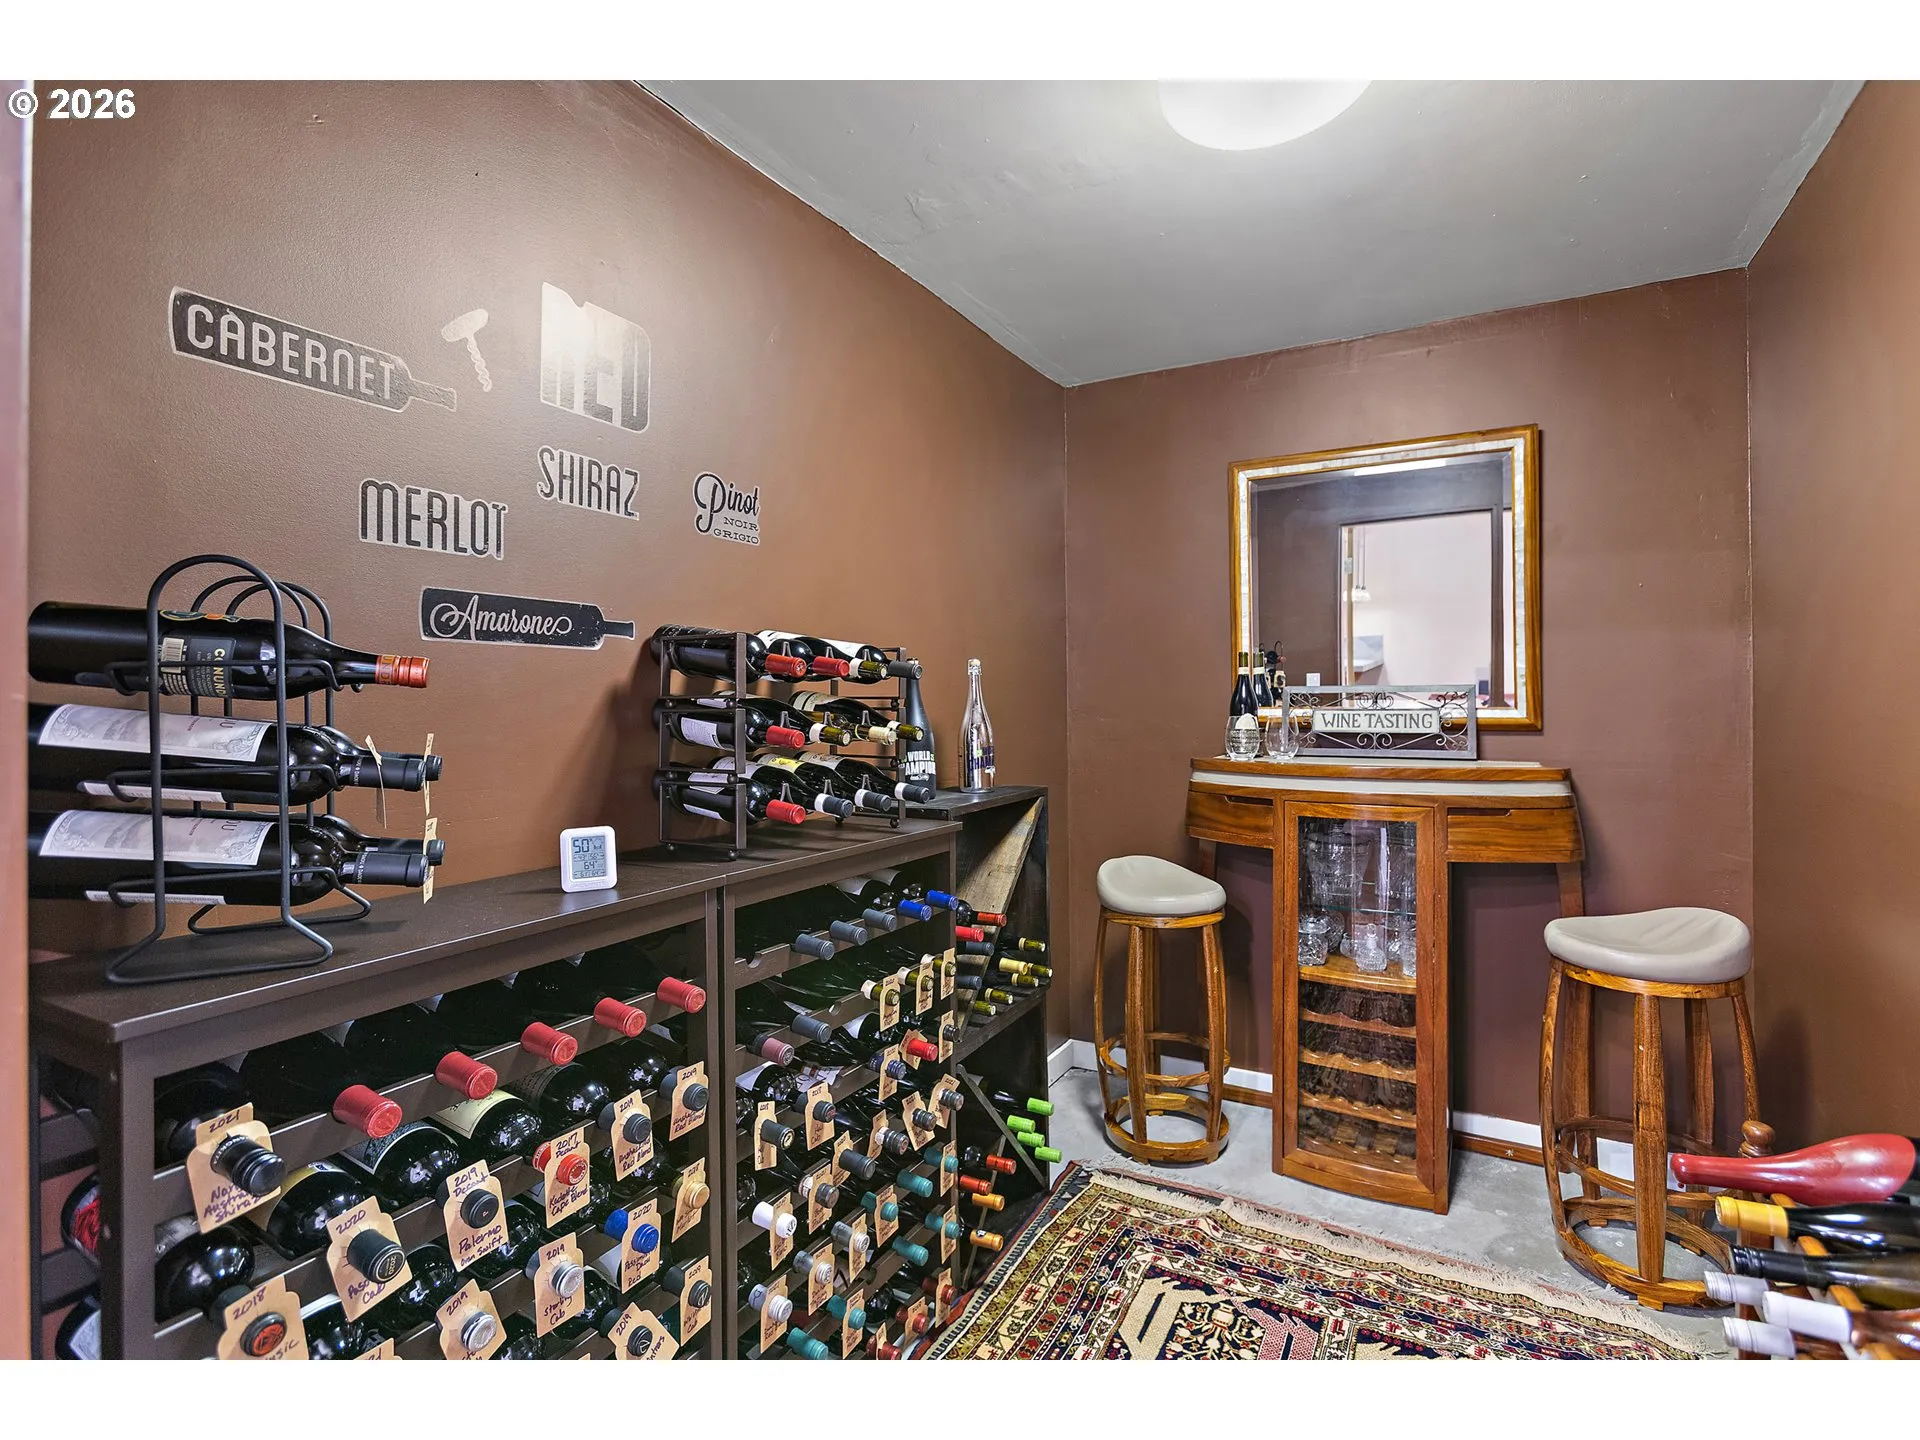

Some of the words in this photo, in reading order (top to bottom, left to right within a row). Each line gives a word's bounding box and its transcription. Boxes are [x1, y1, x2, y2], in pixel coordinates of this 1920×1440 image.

[186, 304, 395, 400] CABERNET
[538, 446, 640, 518] SHIRAZ
[693, 472, 760, 534] Pinot
[360, 479, 507, 559] MERLOT
[723, 516, 760, 532] NOIR
[713, 528, 760, 545] GRIGIO
[429, 594, 573, 641] Amarone
[1320, 712, 1361, 730] WINE
[1364, 712, 1433, 730] TASTING
[907, 750, 931, 762] WORLD
[619, 1097, 635, 1113] 2019
[209, 1109, 240, 1133] 2021
[556, 1132, 578, 1150] 2017
[454, 1166, 479, 1188] 2019
[551, 1200, 570, 1217] Cape
[632, 1203, 653, 1221] 2020
[335, 1209, 367, 1235] 2020
[458, 1225, 502, 1255] Palermo
[477, 1235, 504, 1256] Swift
[546, 1243, 566, 1261] 2019
[232, 1285, 268, 1321] 2018
[446, 1291, 469, 1316] 2019
[549, 1308, 566, 1326] Cab
[615, 1313, 632, 1337] 2019
